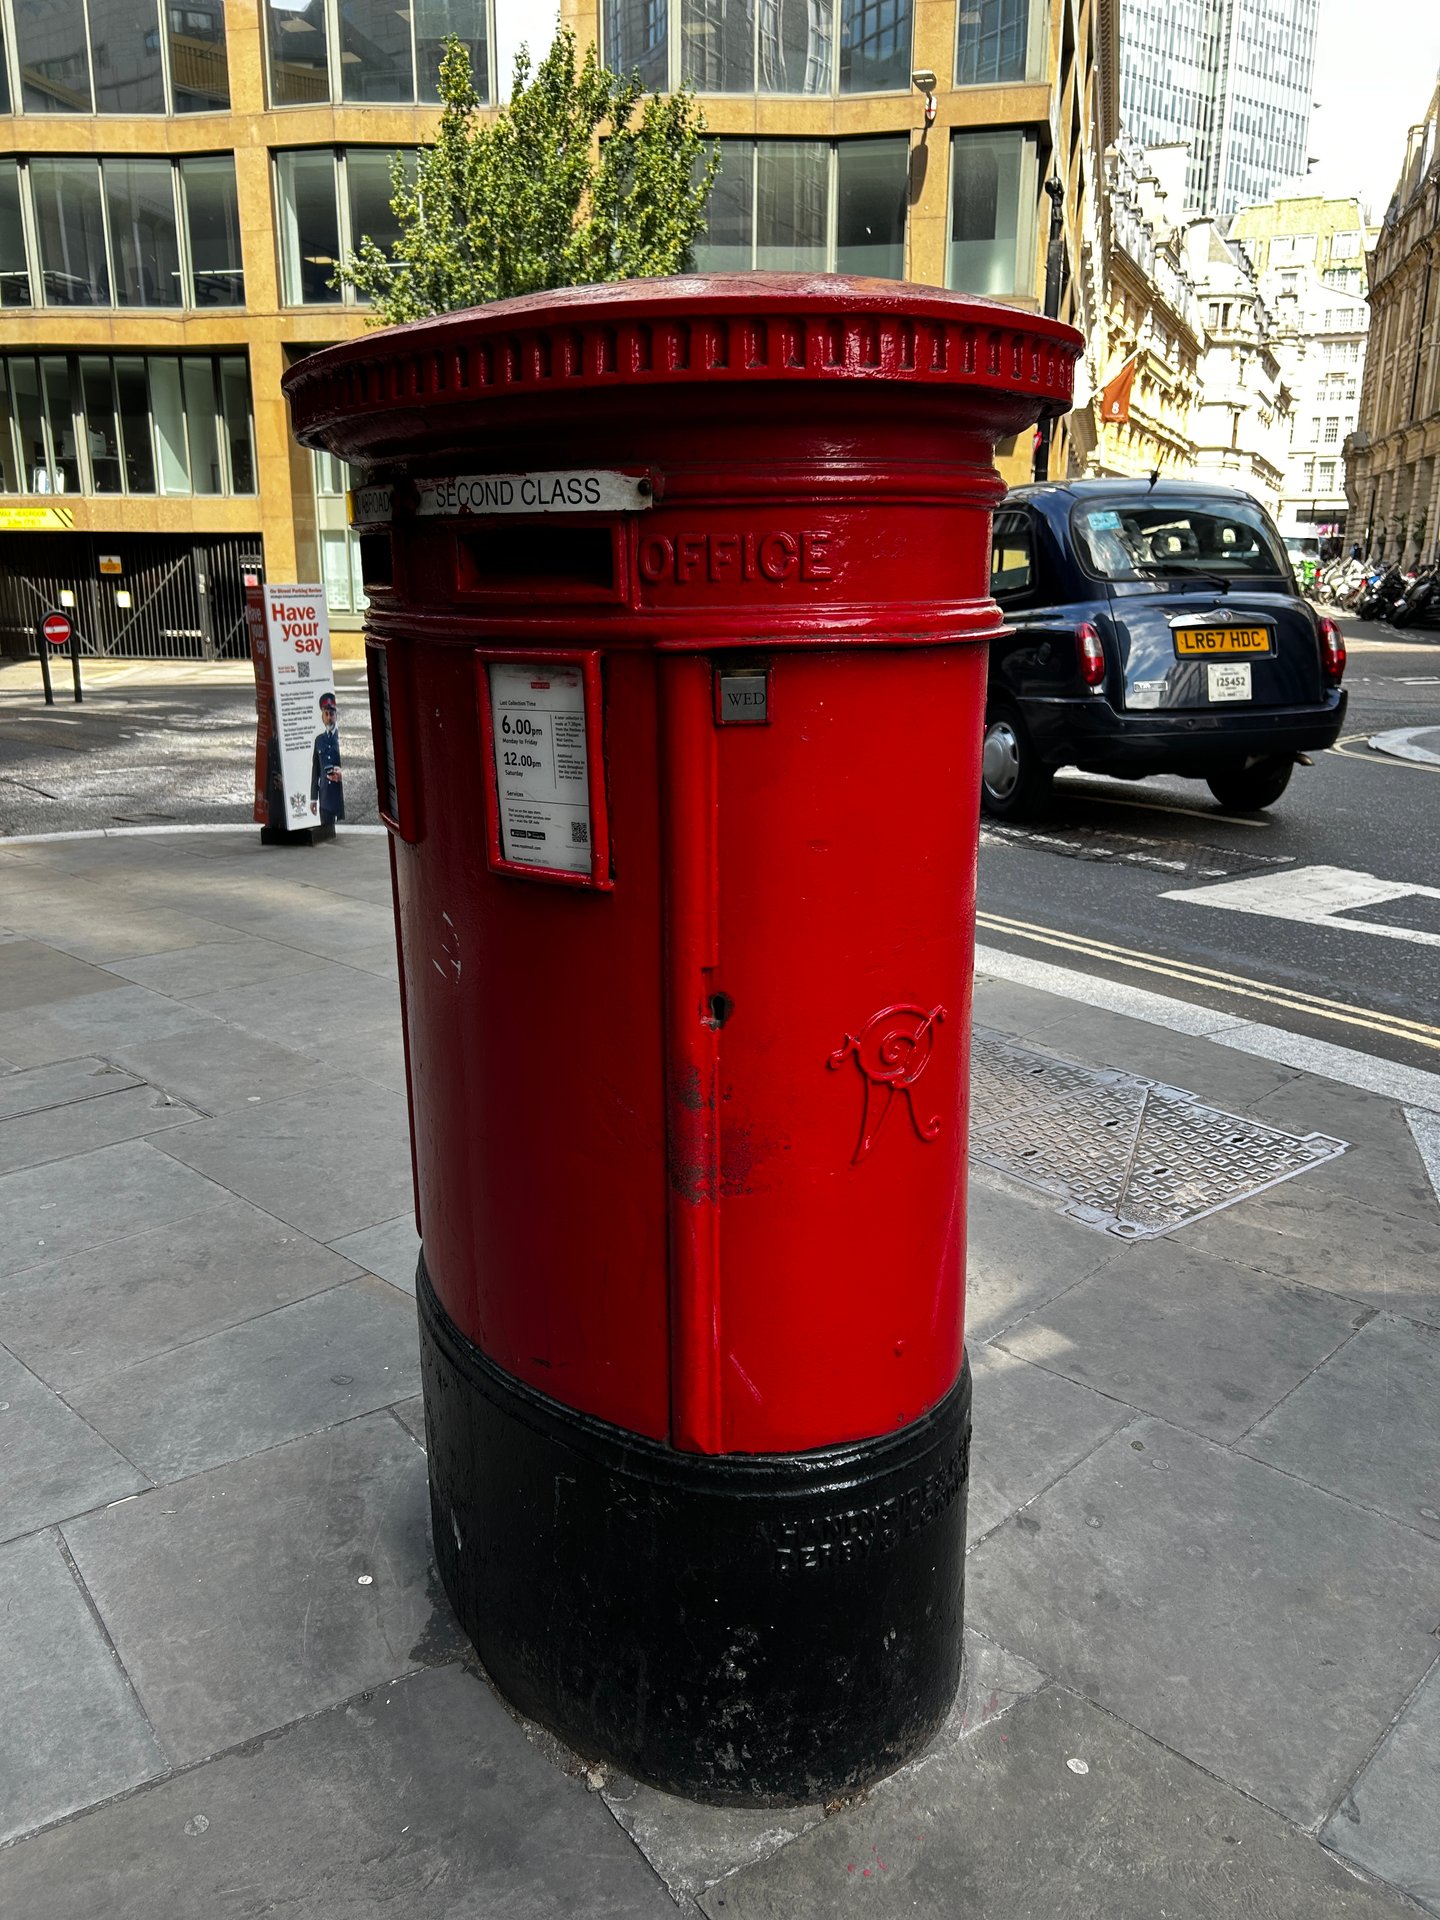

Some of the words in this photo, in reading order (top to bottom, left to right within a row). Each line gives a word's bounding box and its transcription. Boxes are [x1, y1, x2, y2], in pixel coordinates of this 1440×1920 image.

[435, 480, 514, 507] SECOND
[521, 478, 601, 505] CLASS
[639, 531, 833, 583] OFFICE
[271, 603, 316, 622] Have
[281, 622, 319, 642] your
[1183, 632, 1225, 649] LR67
[1231, 631, 1261, 647] HDC
[295, 638, 323, 656] say
[1216, 677, 1246, 688] 125452
[727, 692, 766, 706] WED
[502, 715, 543, 737] 6.00pm
[503, 752, 542, 768] 12.00pm
[505, 770, 524, 778] Saturday
